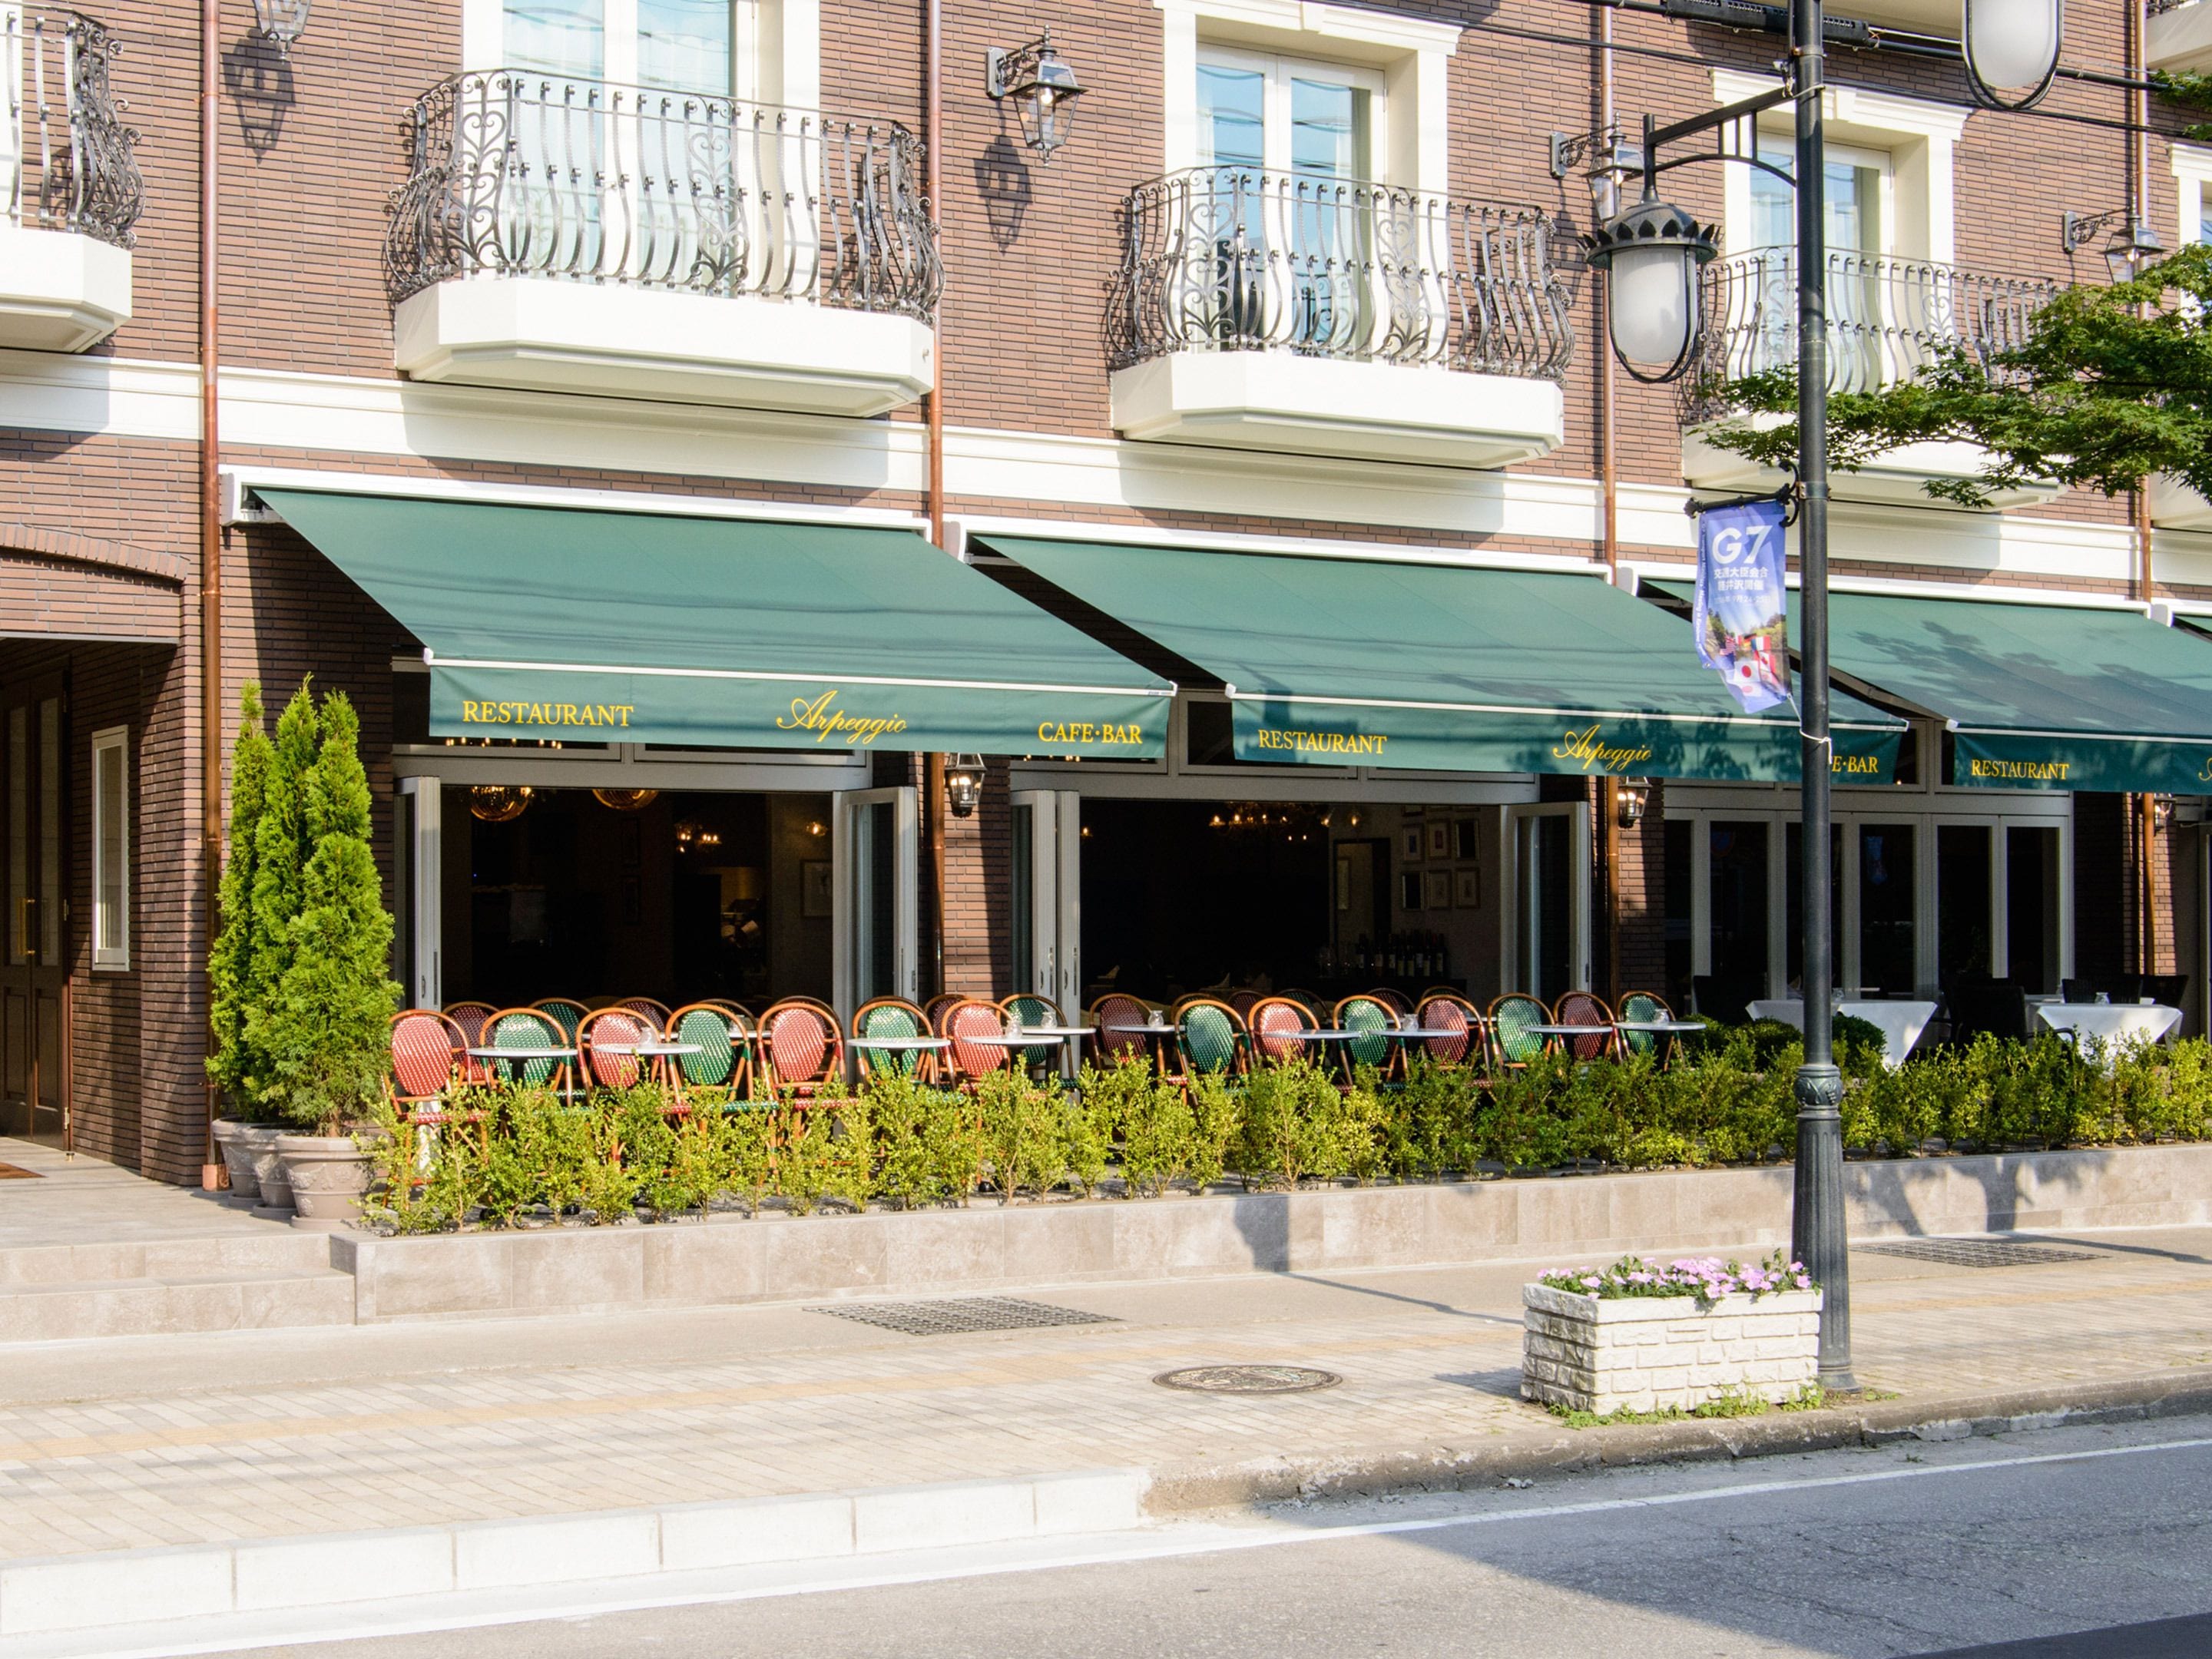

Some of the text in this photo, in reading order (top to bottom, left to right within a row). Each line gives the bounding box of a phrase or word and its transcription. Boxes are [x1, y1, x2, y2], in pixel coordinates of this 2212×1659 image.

[1712, 525, 1773, 565] G7
[462, 700, 634, 727] RESTAURANT
[776, 690, 906, 743] Arpeggio
[1258, 729, 1389, 754] RESTAURANT
[1552, 724, 1651, 771] Arpeggio
[1970, 759, 2071, 781] RESTAURANT
